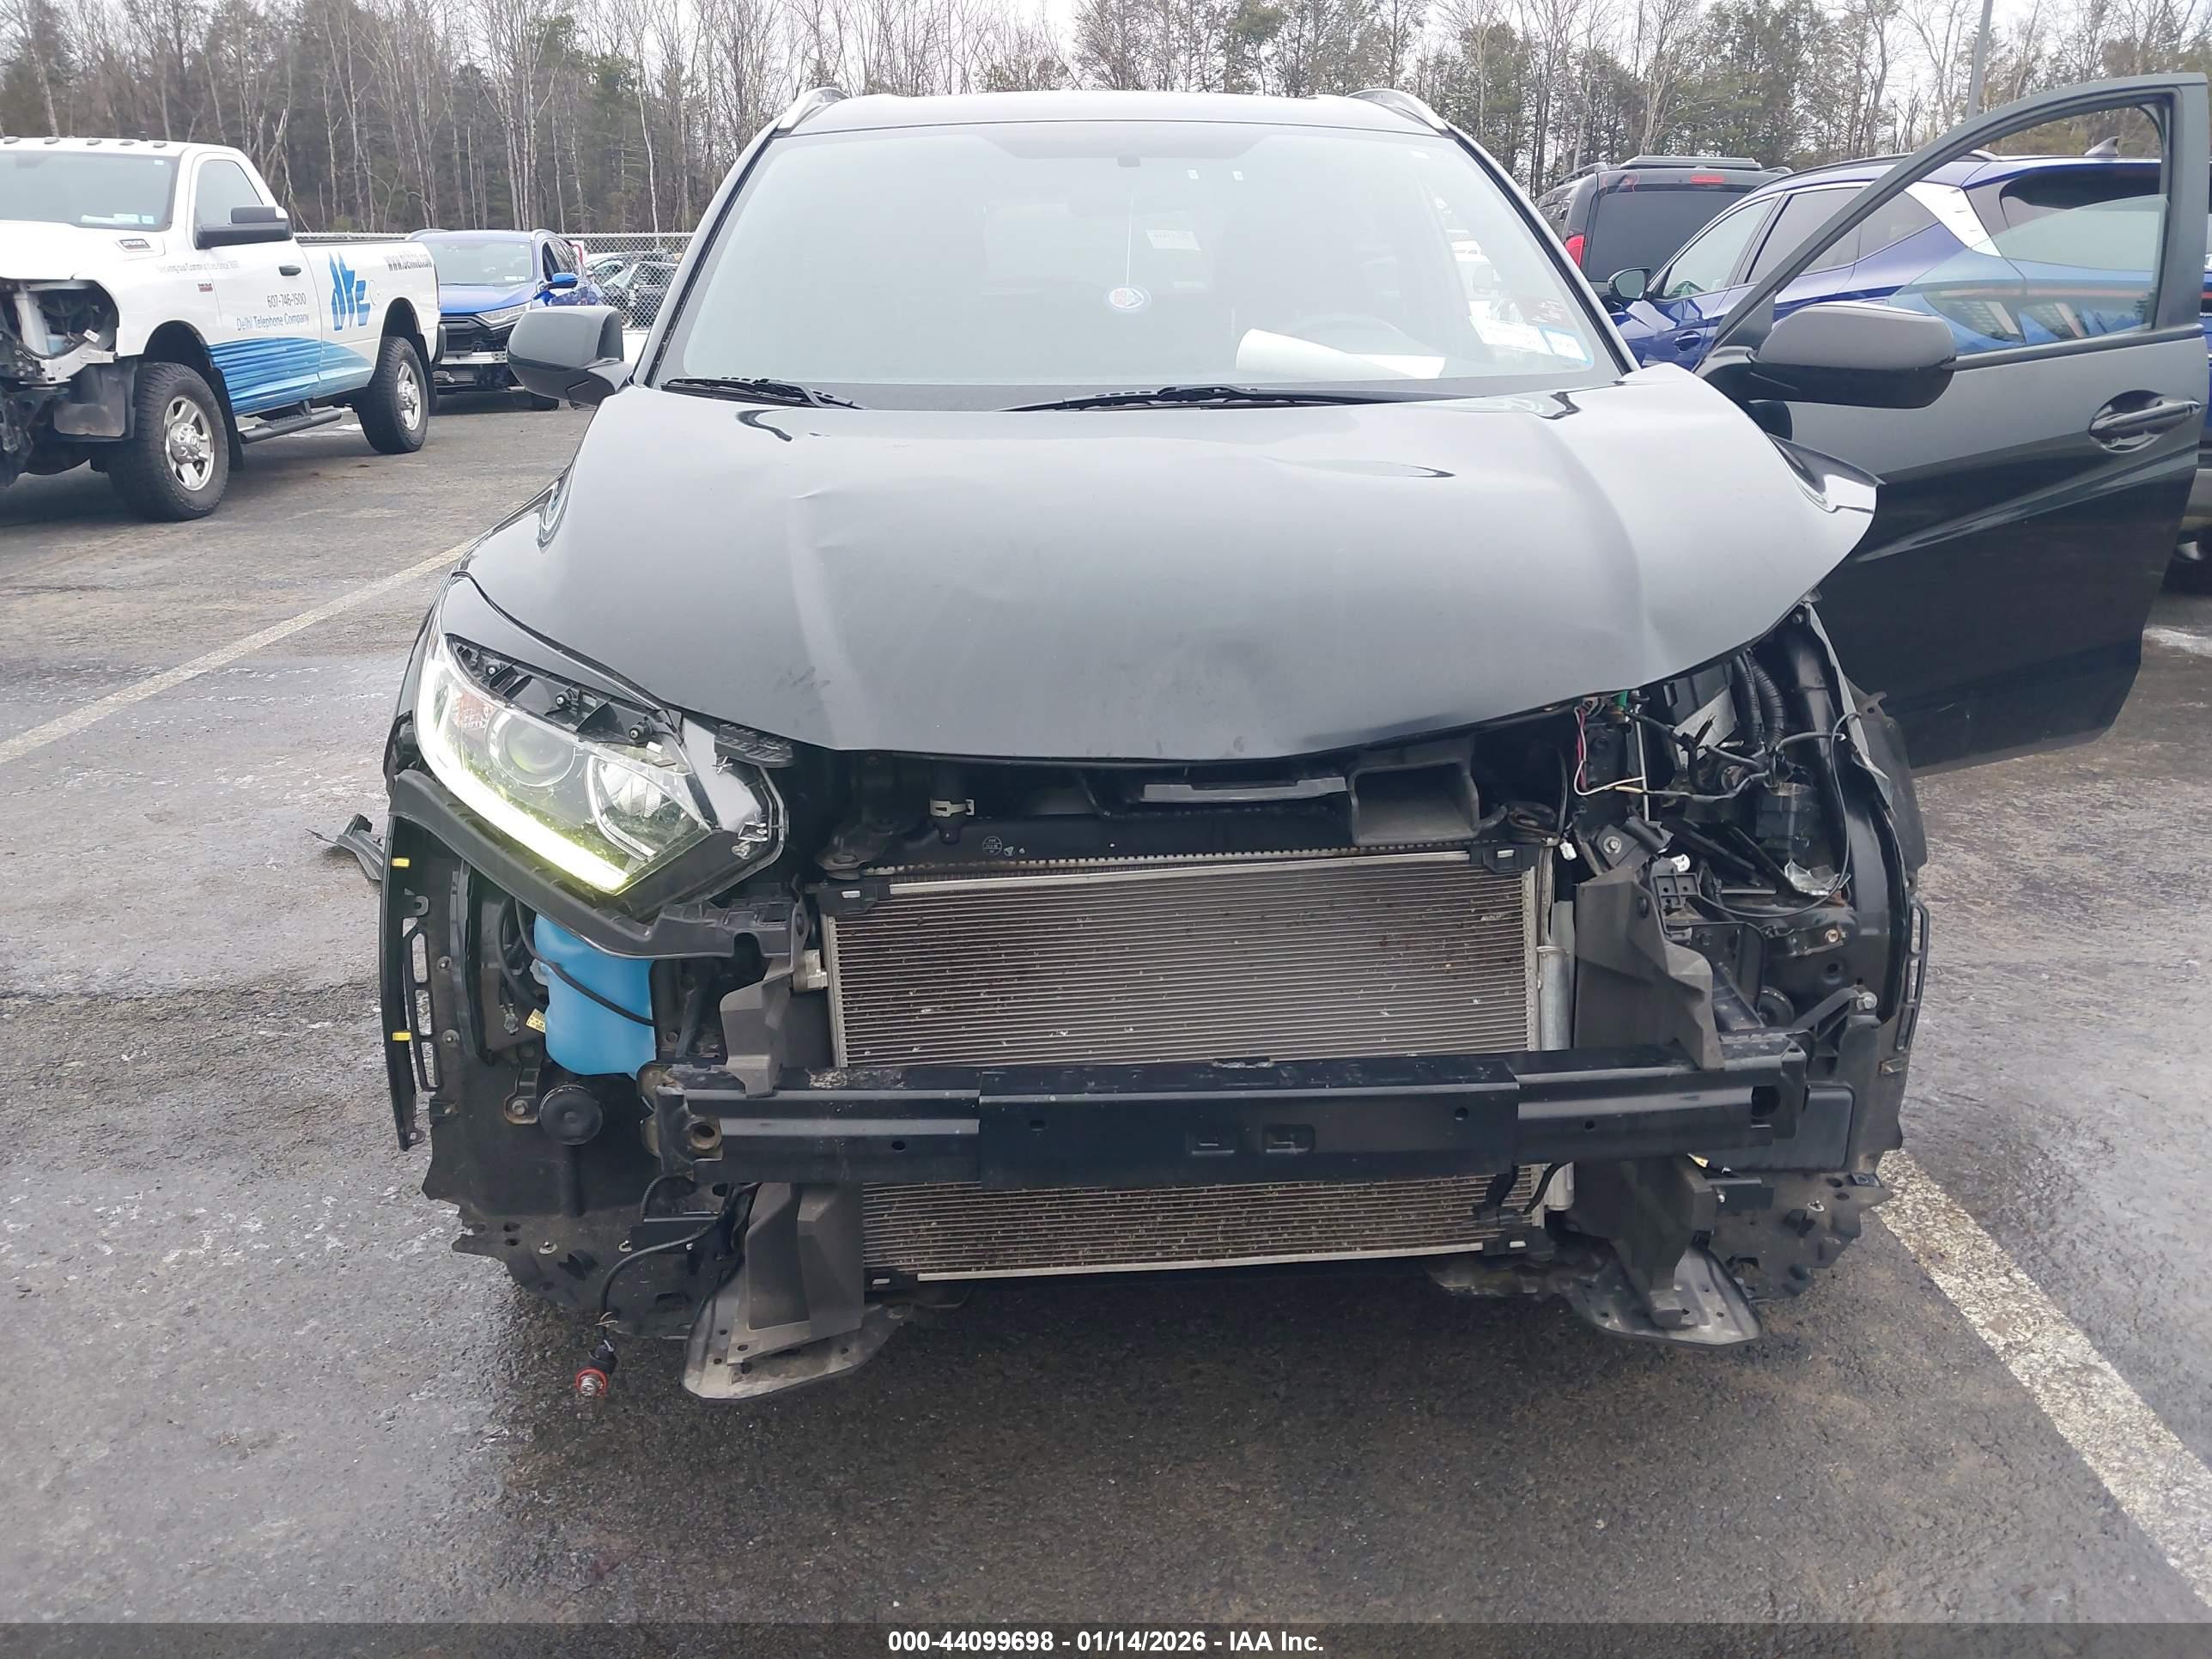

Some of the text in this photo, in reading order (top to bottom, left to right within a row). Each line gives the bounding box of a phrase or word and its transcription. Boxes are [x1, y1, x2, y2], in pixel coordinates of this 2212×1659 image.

[267, 292, 307, 308] 607-746-1500
[236, 313, 309, 331] Delhi Telephone Company
